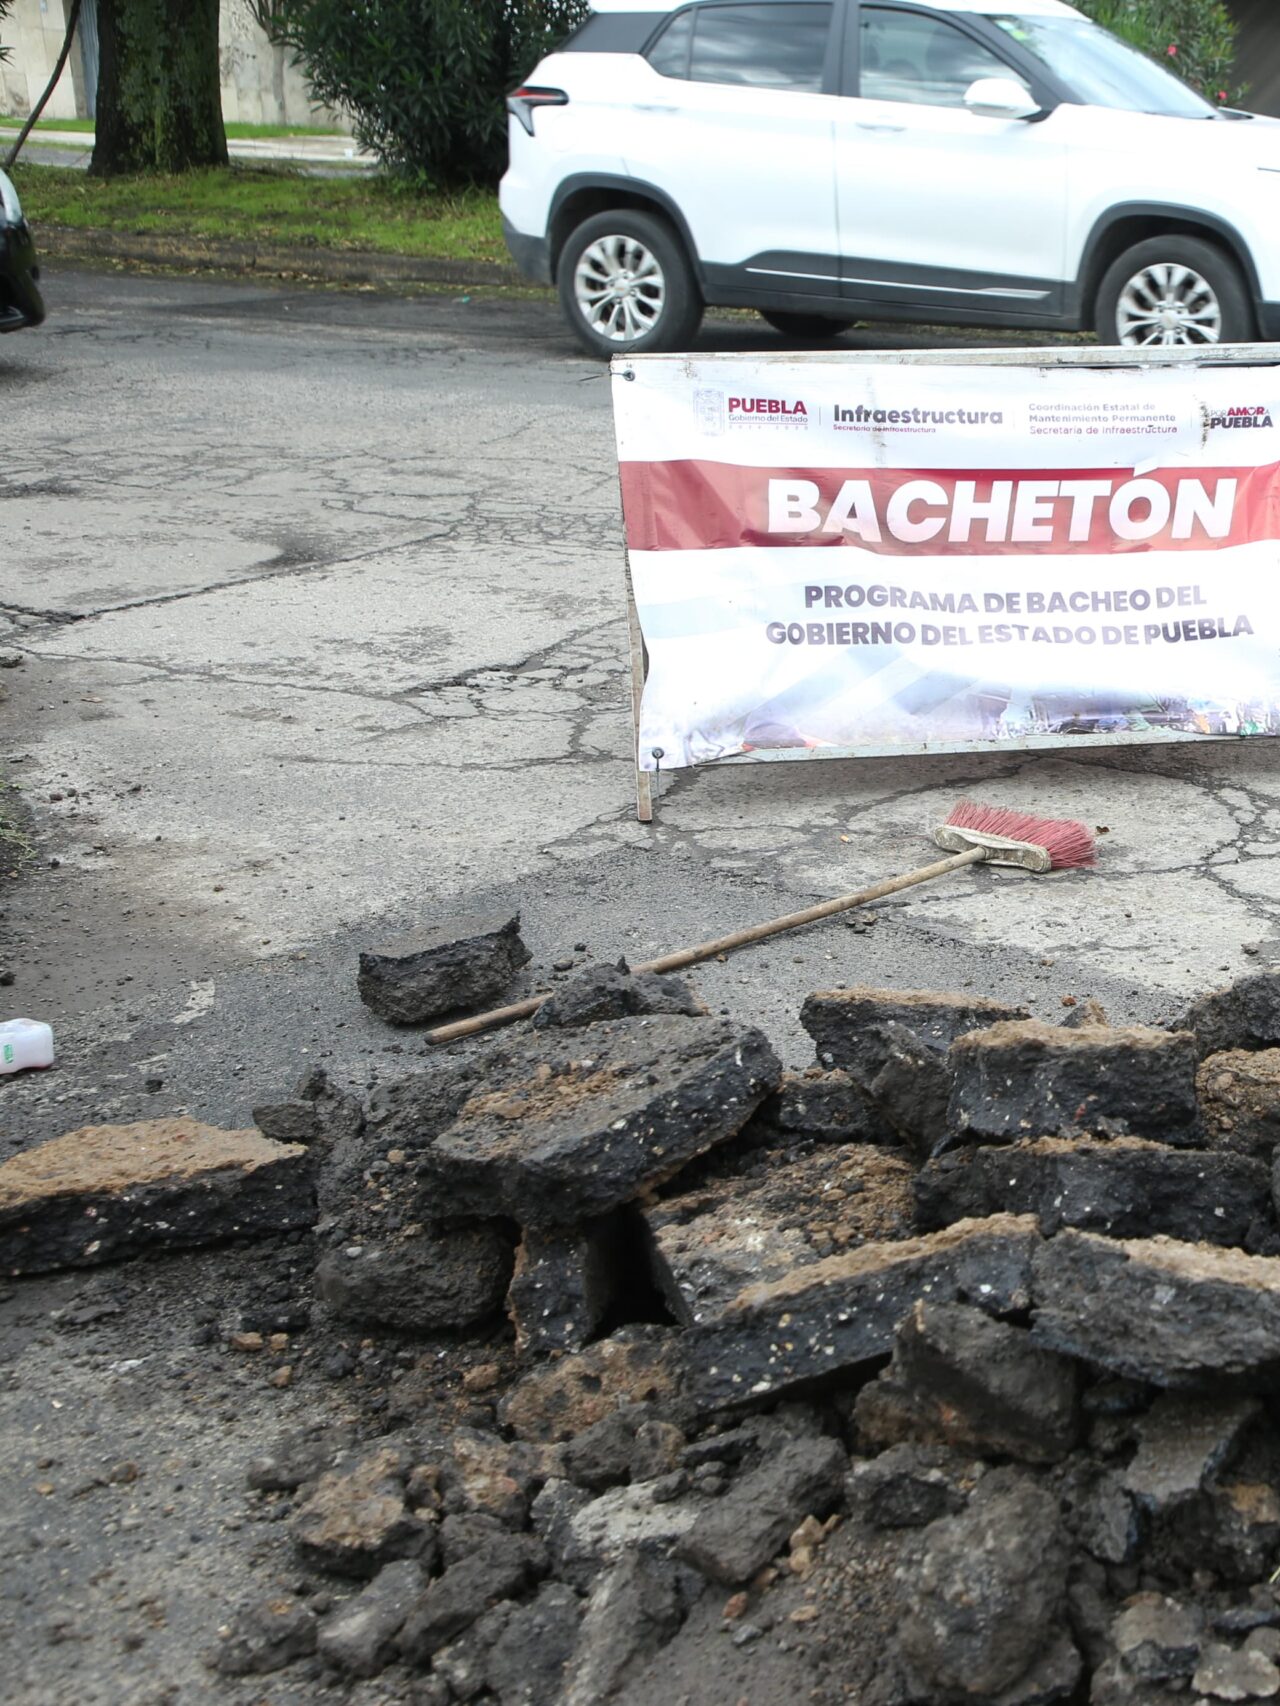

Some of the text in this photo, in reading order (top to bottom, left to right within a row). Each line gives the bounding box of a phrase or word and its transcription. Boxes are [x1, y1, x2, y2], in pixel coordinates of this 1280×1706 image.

[728, 397, 808, 415] PUEBLA
[1028, 402, 1156, 412] Coordinación Estatal de
[1227, 406, 1265, 416] AMOR
[728, 414, 808, 423] Gobierno del Estado
[834, 404, 1003, 424] Infraestructura
[1029, 413, 1176, 422] Mantenimiento Permanente
[1210, 415, 1274, 429] PUEBLA
[1086, 424, 1099, 435] de
[1102, 424, 1178, 434] Infraestructura
[767, 458, 1238, 543] BACHETÓN
[804, 584, 1207, 614] PROGRAMA DE BACHEO DEL
[766, 614, 1255, 647] GOBIERNO DEL ESTADO DE PUEBLA
